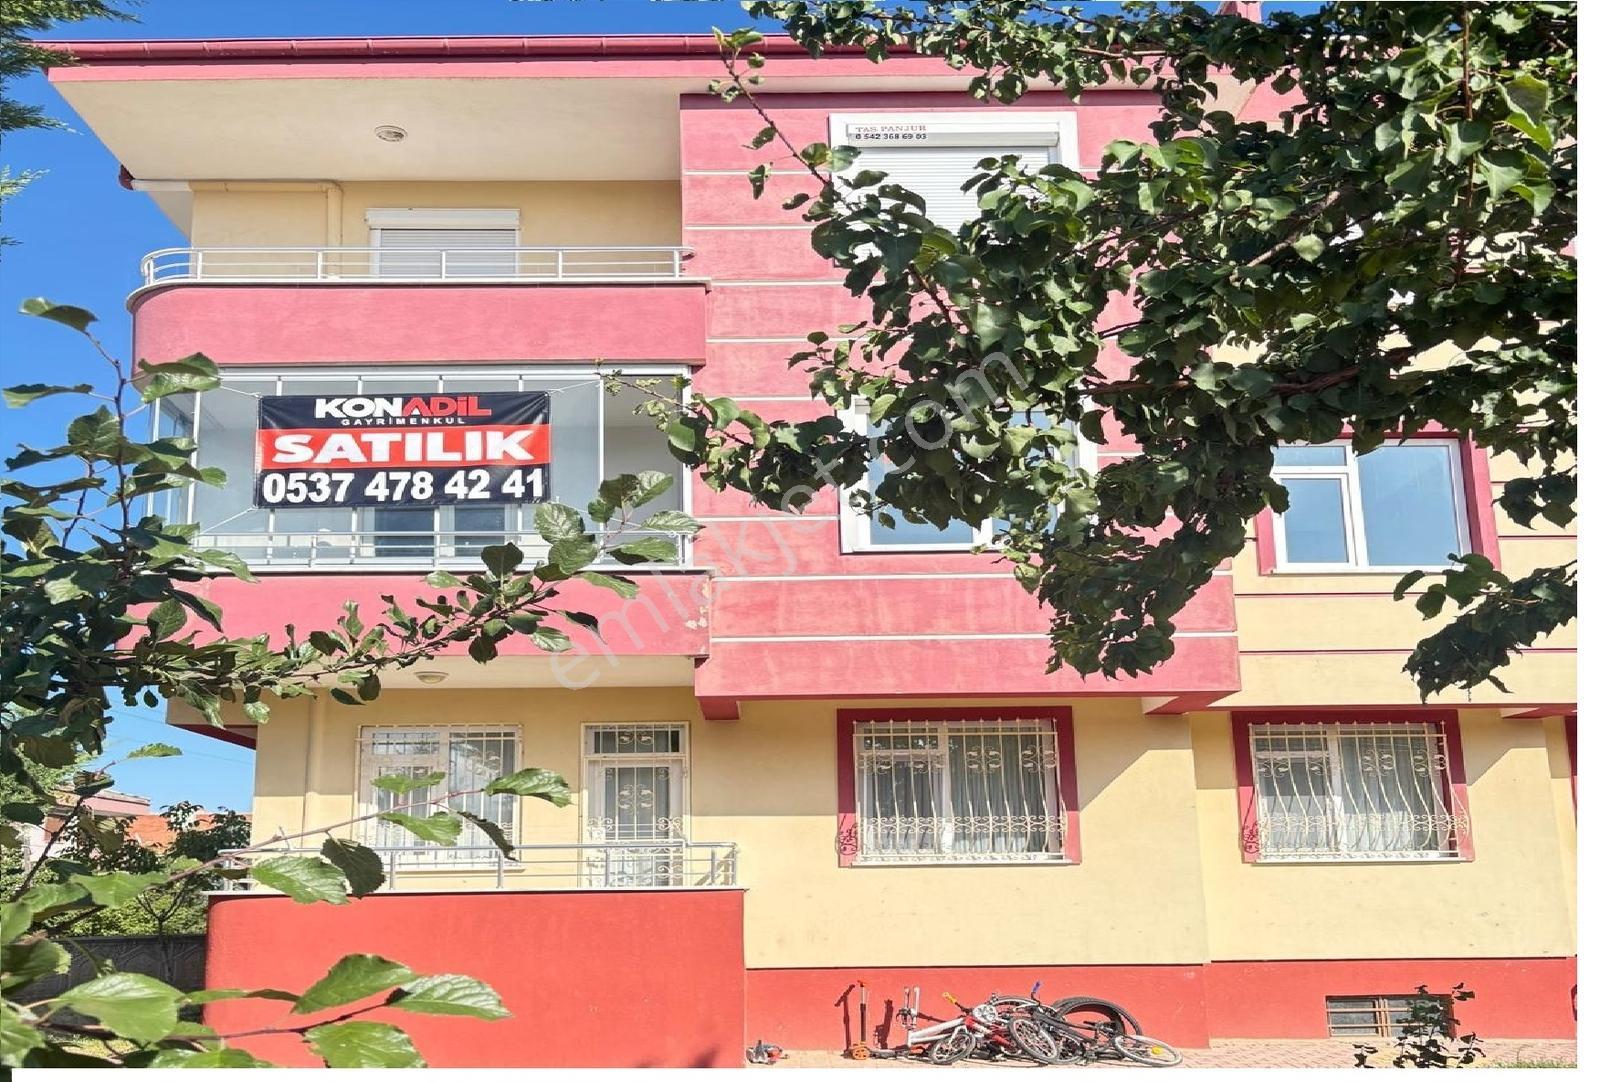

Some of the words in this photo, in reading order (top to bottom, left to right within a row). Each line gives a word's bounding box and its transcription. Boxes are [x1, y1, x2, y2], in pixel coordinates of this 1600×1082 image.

[272, 430, 534, 463] SATILIK
[263, 473, 355, 503] 0537
[364, 470, 434, 502] 478
[444, 469, 491, 500] 42
[502, 468, 544, 498] 41
